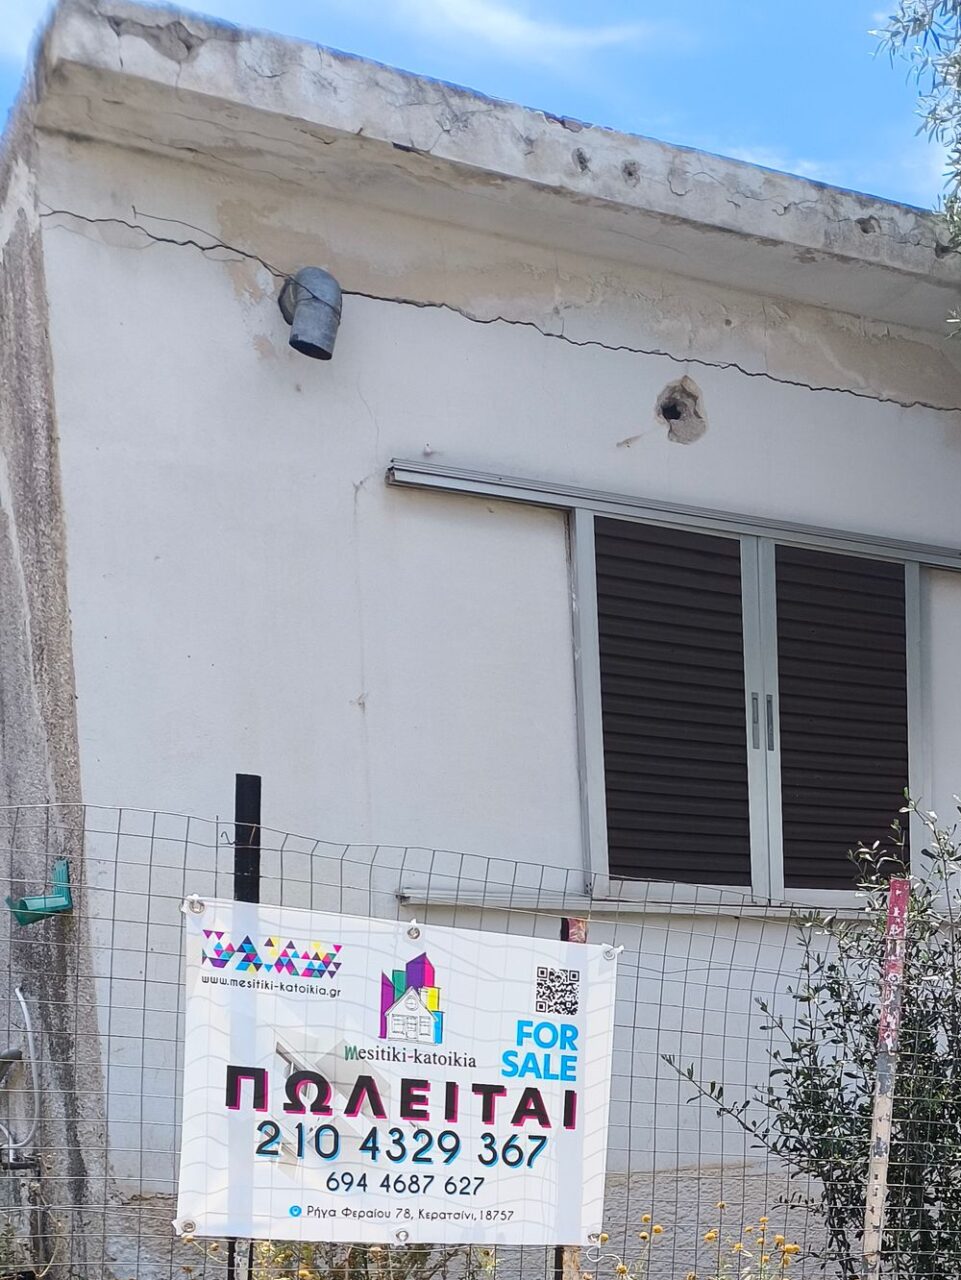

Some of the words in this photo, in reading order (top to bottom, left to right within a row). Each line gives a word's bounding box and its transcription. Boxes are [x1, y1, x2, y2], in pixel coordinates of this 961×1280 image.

[201, 975, 342, 998] www.mesitiki-katoikia.gr
[517, 1020, 578, 1051] FOR
[344, 1045, 477, 1067] Mesitiki-katoikia
[501, 1051, 578, 1081] SALE
[225, 1065, 577, 1129] ΠΩΛΕΙΤΑΙ
[255, 1120, 341, 1160] 210
[358, 1126, 461, 1165] 4329
[478, 1132, 548, 1169] 367
[326, 1171, 368, 1192] 694
[379, 1174, 435, 1194] 4687
[444, 1176, 485, 1196] 627
[306, 1205, 337, 1219] Ρήγα
[341, 1207, 391, 1220] Φεραίου
[395, 1208, 414, 1220] 78,
